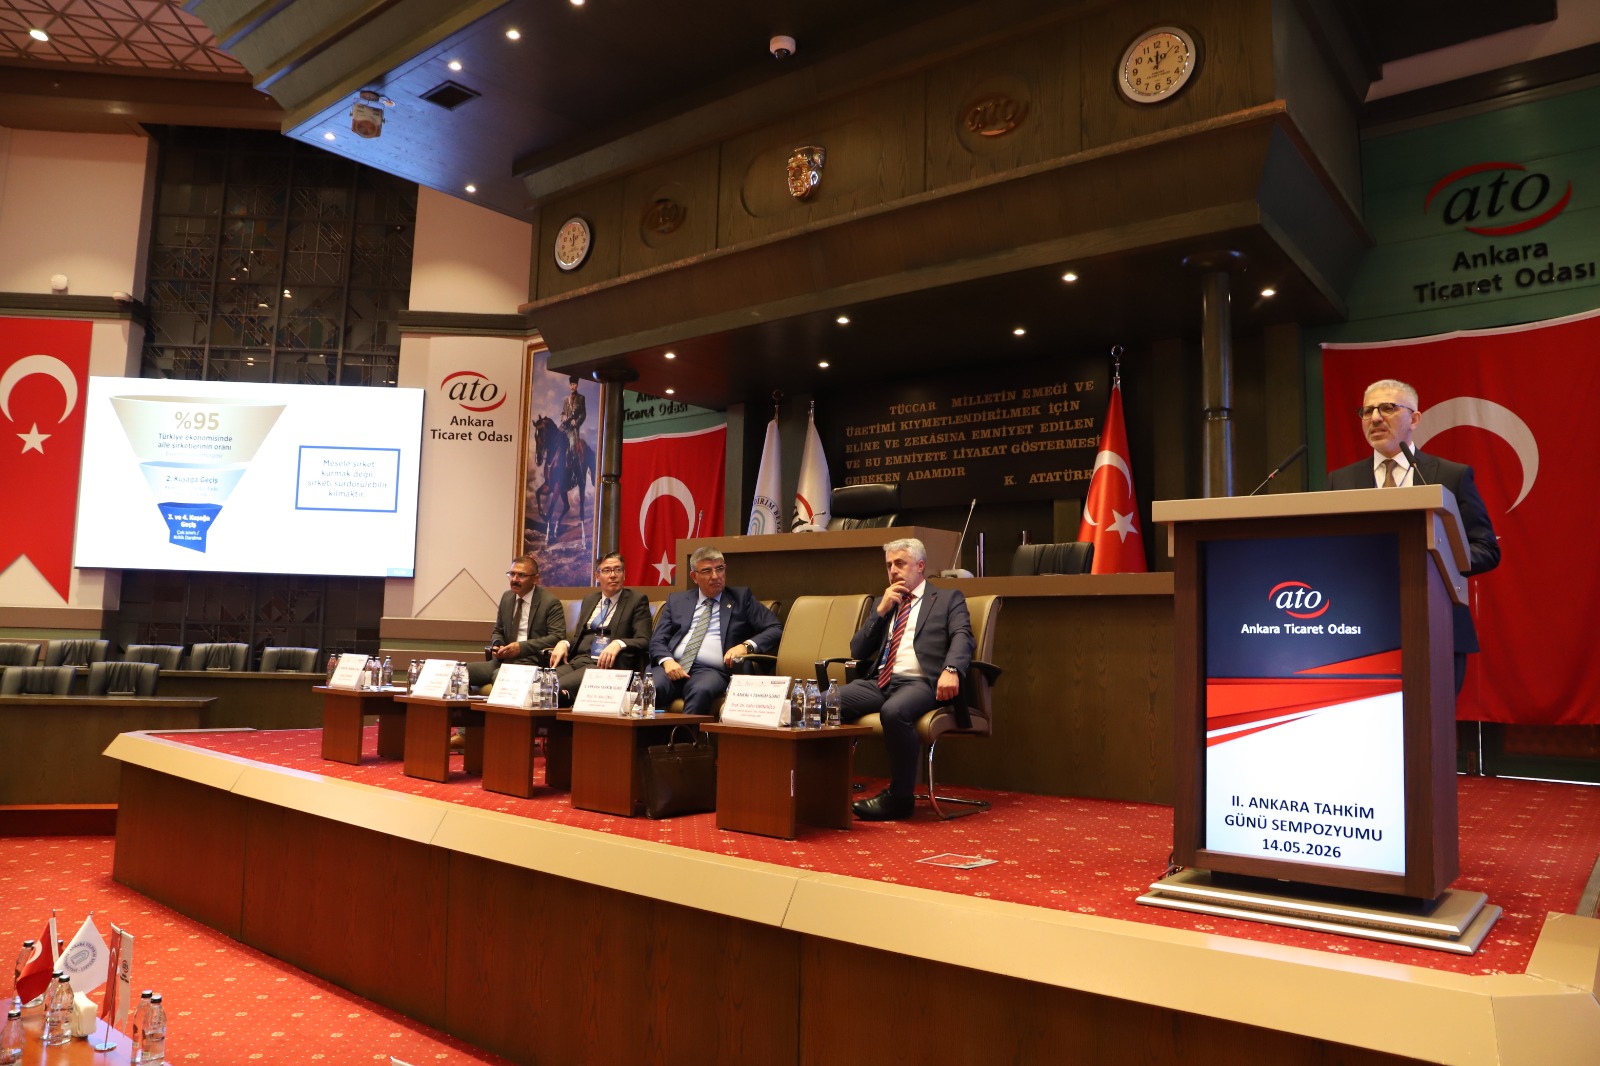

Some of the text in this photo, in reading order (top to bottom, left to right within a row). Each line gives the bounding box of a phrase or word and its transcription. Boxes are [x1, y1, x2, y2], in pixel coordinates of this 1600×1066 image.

[1147, 53, 1166, 64] AO
[1443, 172, 1550, 225] ato
[1452, 242, 1548, 272] Ankara
[1414, 262, 1596, 303] Ticaret Odası
[449, 378, 498, 402] ato
[889, 402, 937, 415] TÜCCAR
[952, 390, 1016, 408] MİLLETİN
[1074, 380, 1094, 392] VE
[175, 411, 219, 430] %95
[450, 416, 494, 427] Ankara
[845, 400, 1080, 437] ÜRETİMİ KIYMETLENDİRİLMEK İÇİN
[430, 429, 512, 442] Ticaret Odası
[884, 439, 900, 449] VE
[904, 432, 966, 447] ZEKÂSINA
[971, 424, 1034, 441] EMNİYET
[845, 434, 1102, 470] VE BU EMNİYETE LİYAKAT GÖSTERMESİ
[844, 466, 966, 486] GEREKEN ADAMDIR
[1004, 468, 1094, 486] K. ATATÜRK
[1276, 588, 1322, 610] ato
[1241, 623, 1361, 635] Ankara Ticaret Odası
[1231, 795, 1375, 820] II. ANKARA TAHKİM
[1224, 814, 1382, 842] GÜNÜ SEMPOZYUMU
[1262, 838, 1342, 858] 14.05.2026
